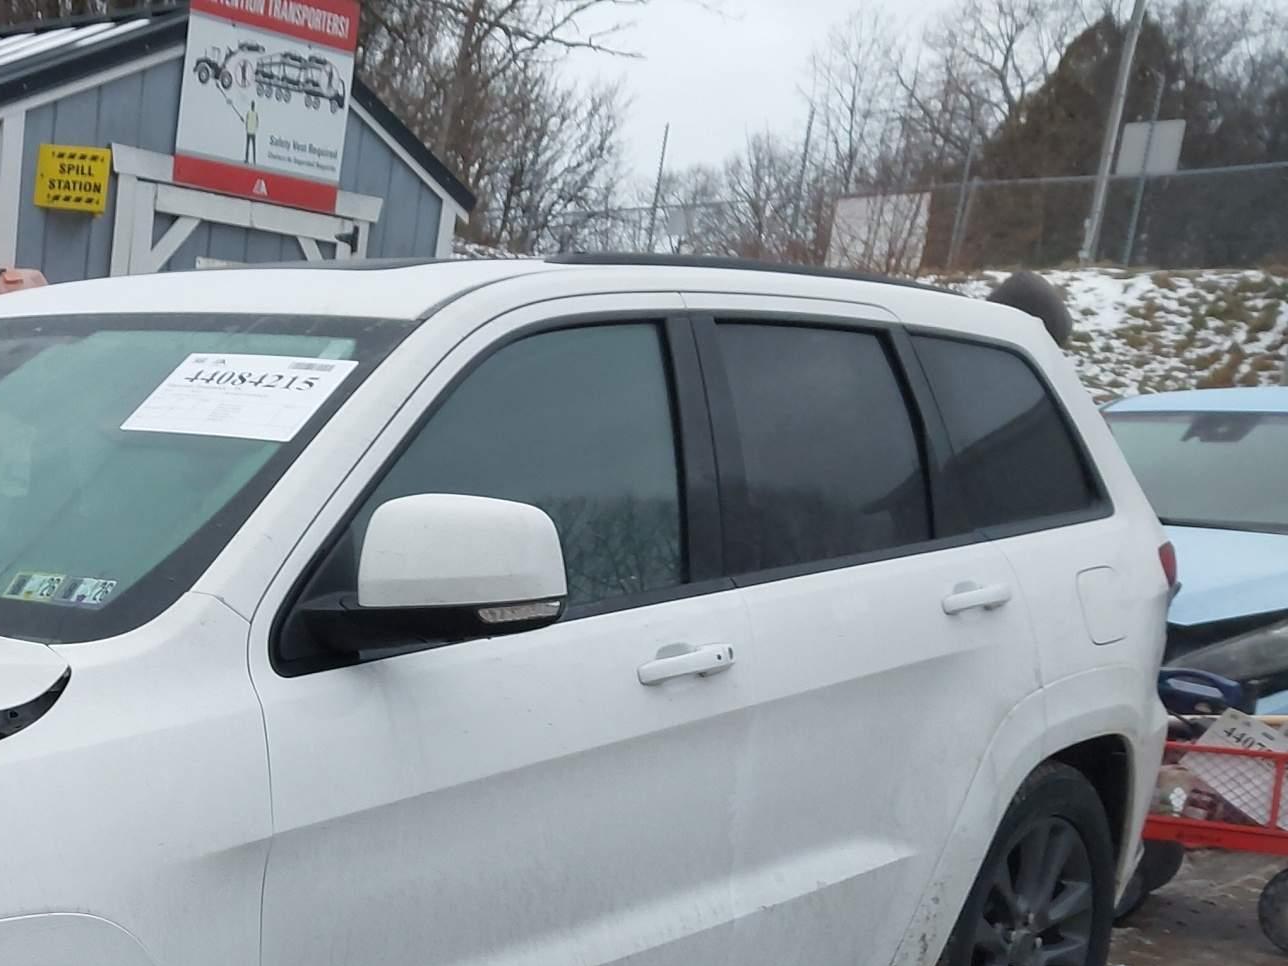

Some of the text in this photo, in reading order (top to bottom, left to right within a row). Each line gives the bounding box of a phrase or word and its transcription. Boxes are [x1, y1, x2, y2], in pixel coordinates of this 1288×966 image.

[268, 0, 350, 39] TRANSPORTERS!
[59, 163, 94, 177] SPILL
[48, 178, 101, 193] STATION
[184, 369, 320, 391] 44084215
